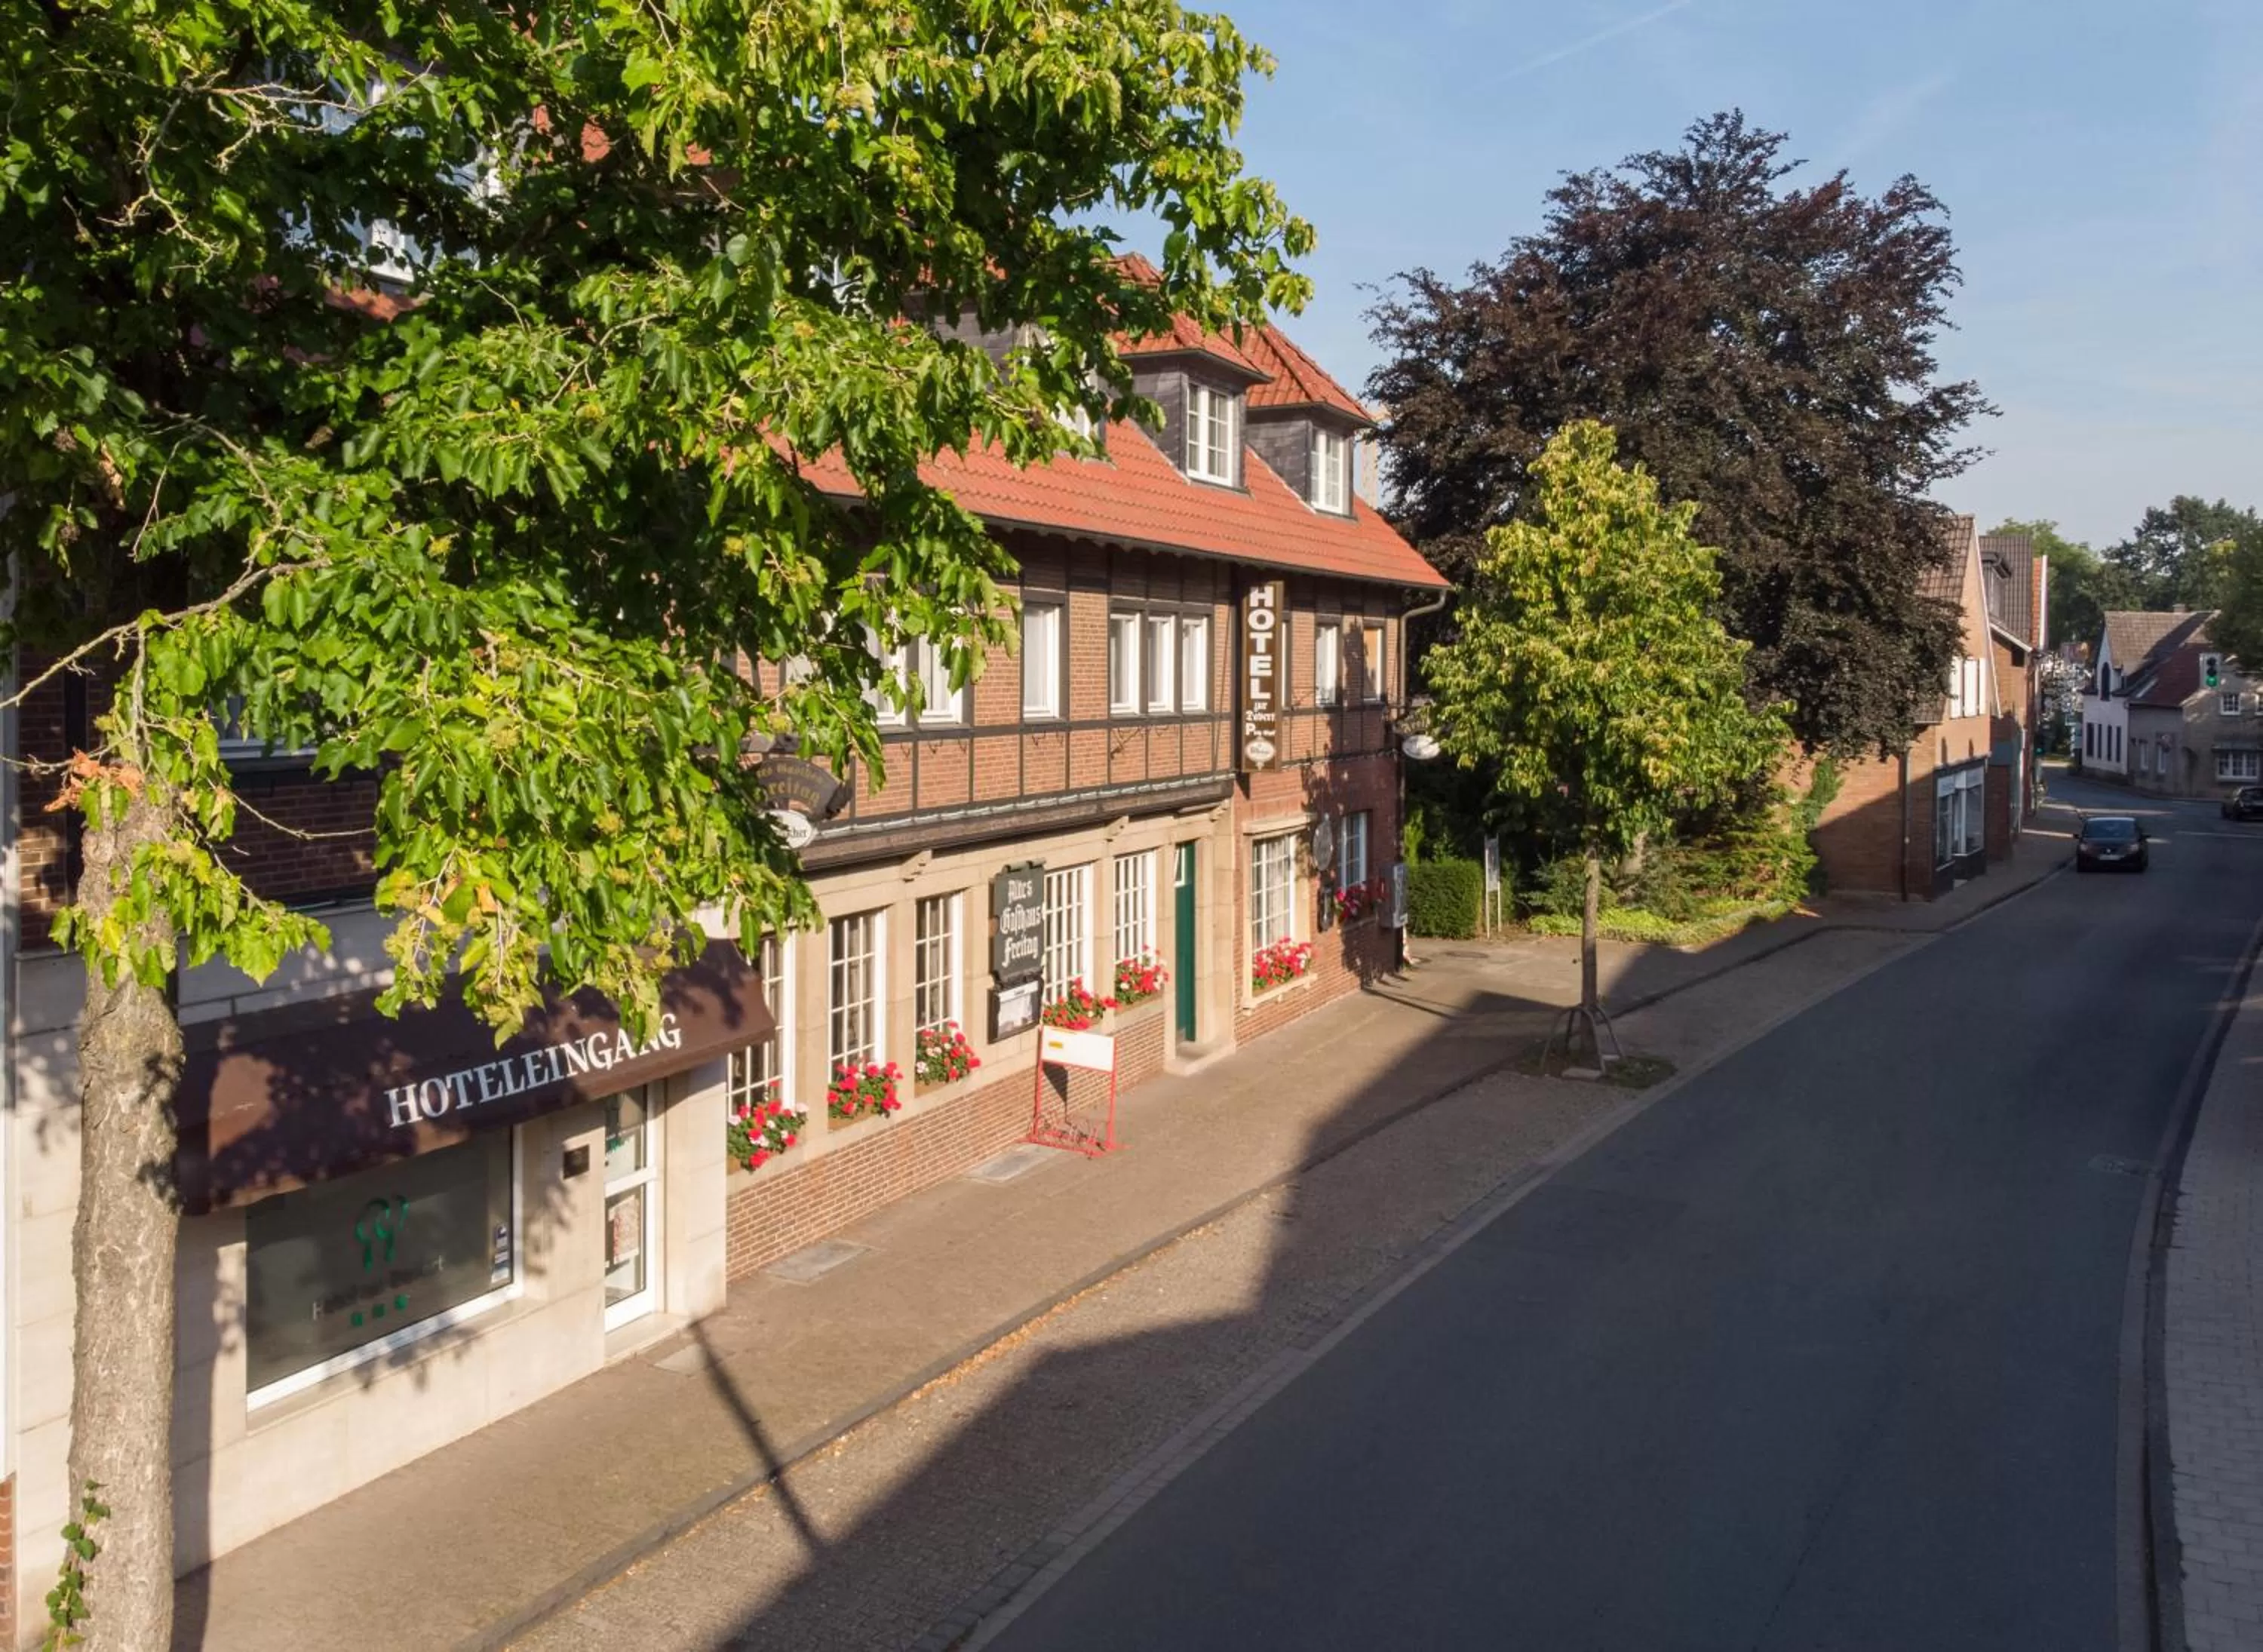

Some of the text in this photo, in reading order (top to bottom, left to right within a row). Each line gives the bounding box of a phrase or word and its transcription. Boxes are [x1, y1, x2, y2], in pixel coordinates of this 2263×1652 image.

[1248, 586, 1275, 700] HOTEL
[999, 903, 1041, 935] Gasthaus
[1002, 935, 1039, 968] Freitag
